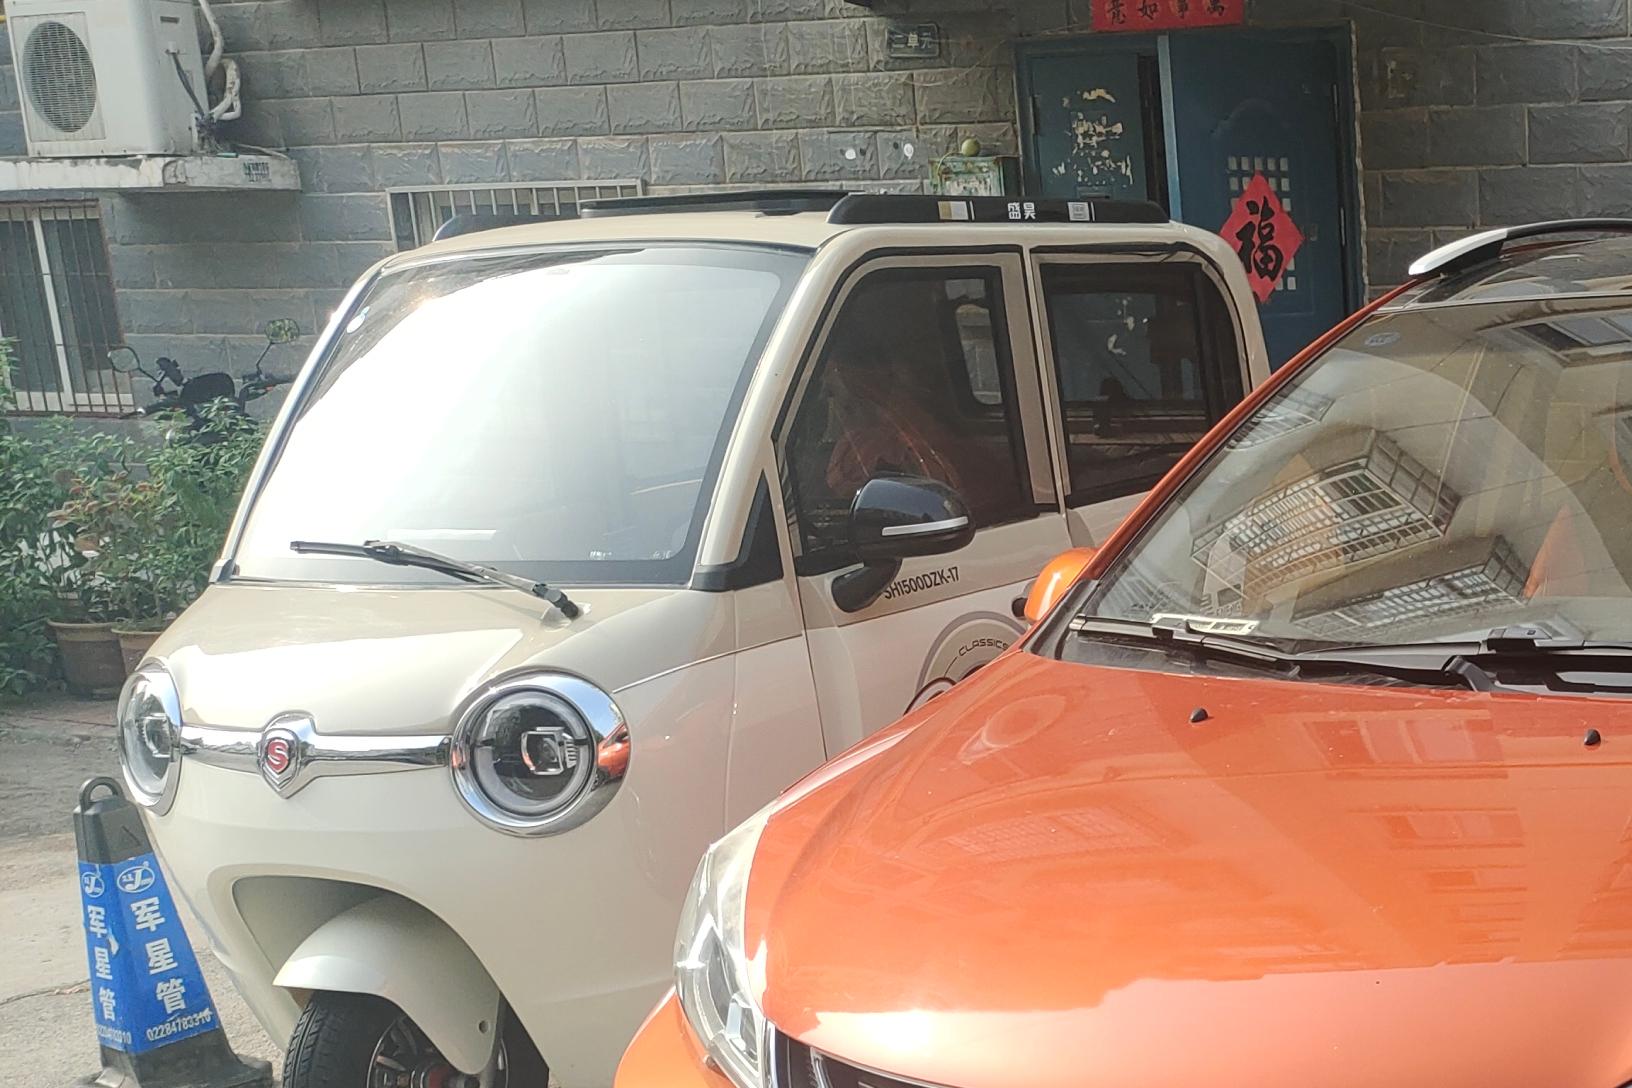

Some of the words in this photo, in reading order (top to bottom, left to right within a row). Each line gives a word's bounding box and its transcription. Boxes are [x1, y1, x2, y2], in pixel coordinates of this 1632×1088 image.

[1236, 195, 1284, 282] 福
[130, 897, 186, 1014] 军星管
